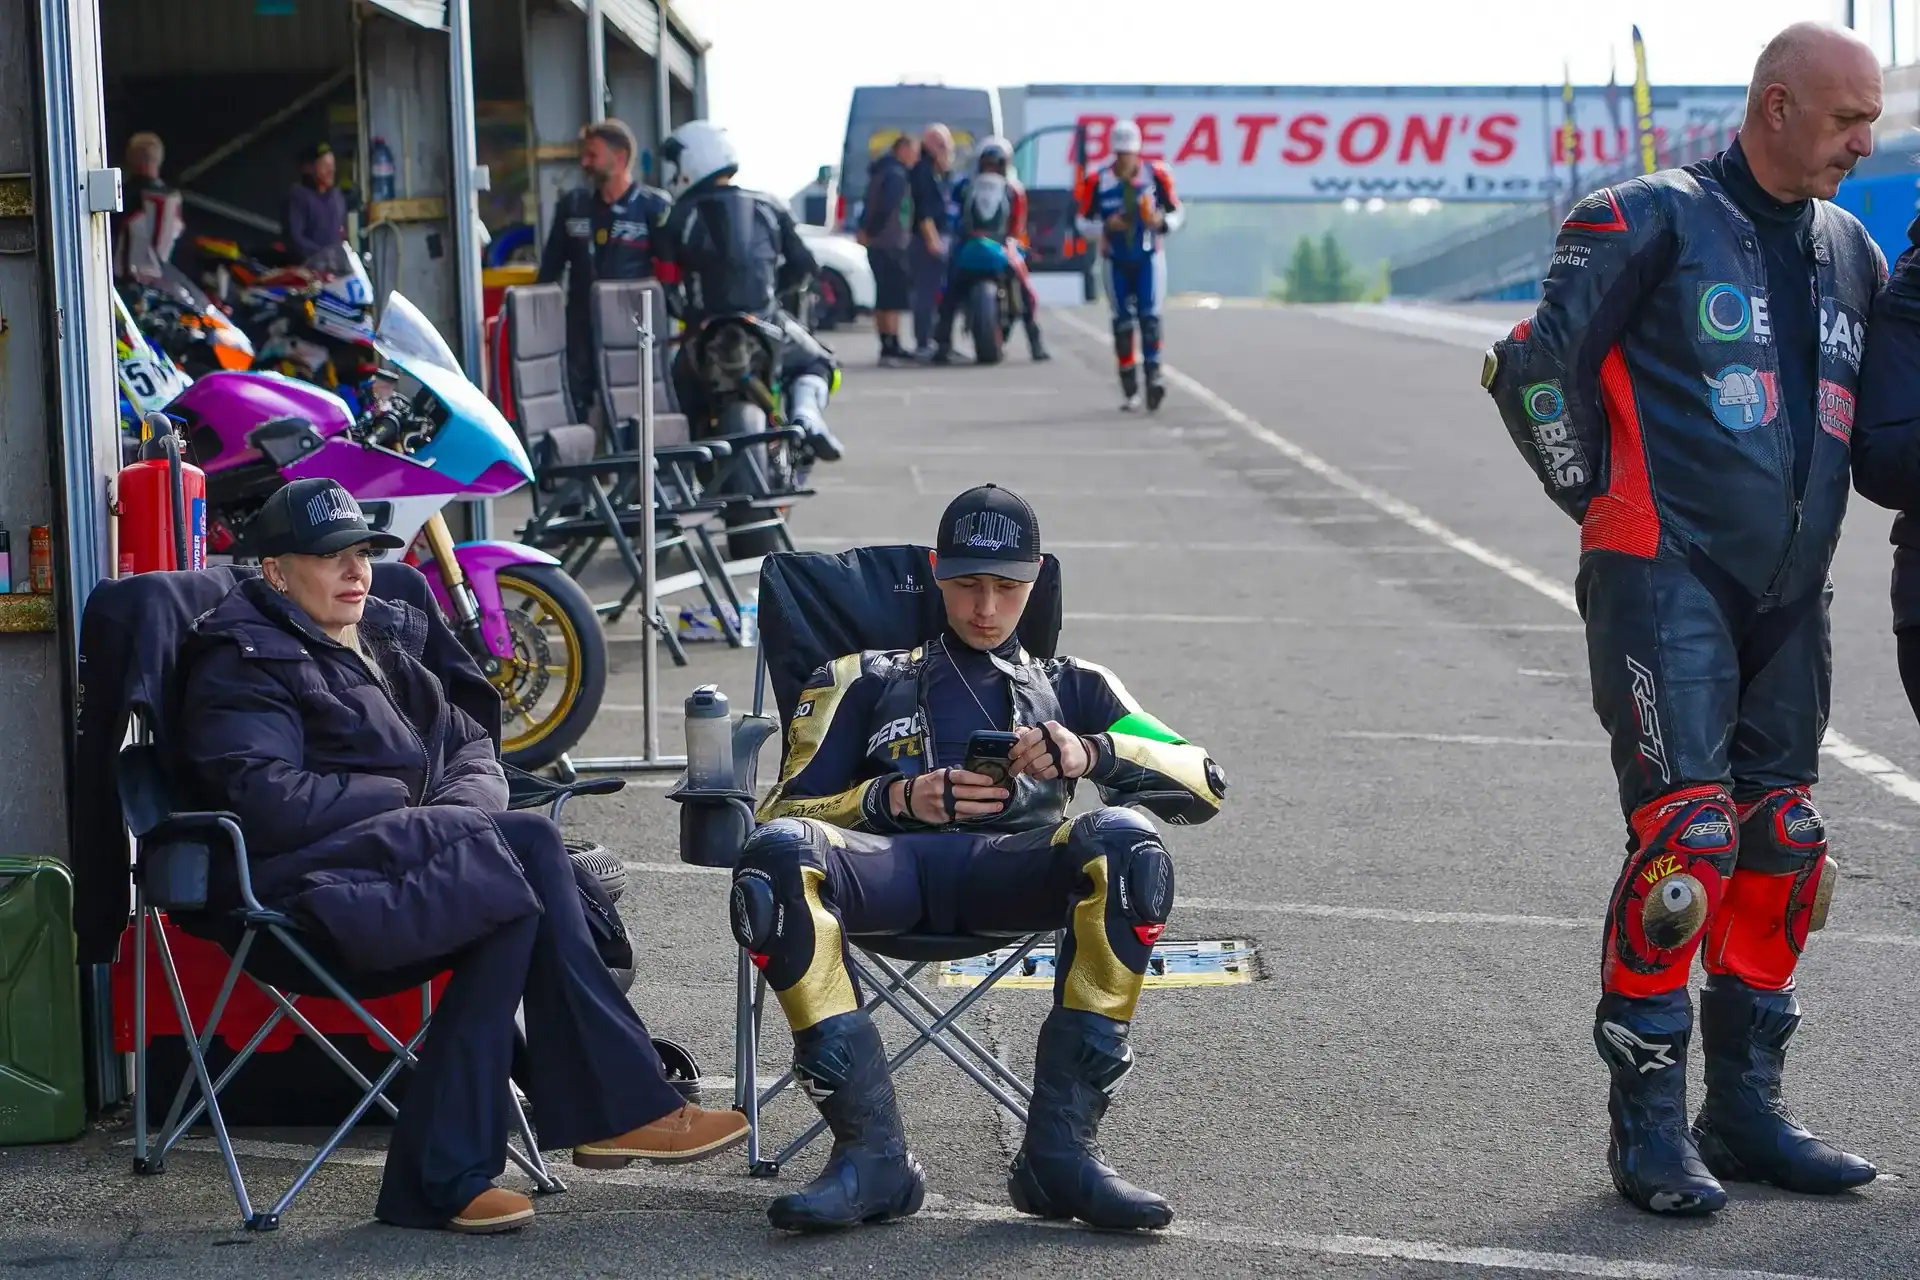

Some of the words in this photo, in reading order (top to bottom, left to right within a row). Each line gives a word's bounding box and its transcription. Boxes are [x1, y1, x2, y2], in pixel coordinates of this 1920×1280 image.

[1067, 112, 1519, 166] BEATSON'S
[1569, 244, 1592, 256] WITH
[1532, 425, 1548, 456] GROUP
[952, 512, 977, 545] RIDE
[977, 511, 1023, 549] CULTURE
[965, 533, 1004, 551] Racing
[193, 534, 201, 571] OWDER
[1625, 653, 1671, 785] RST
[1681, 821, 1734, 840] RST
